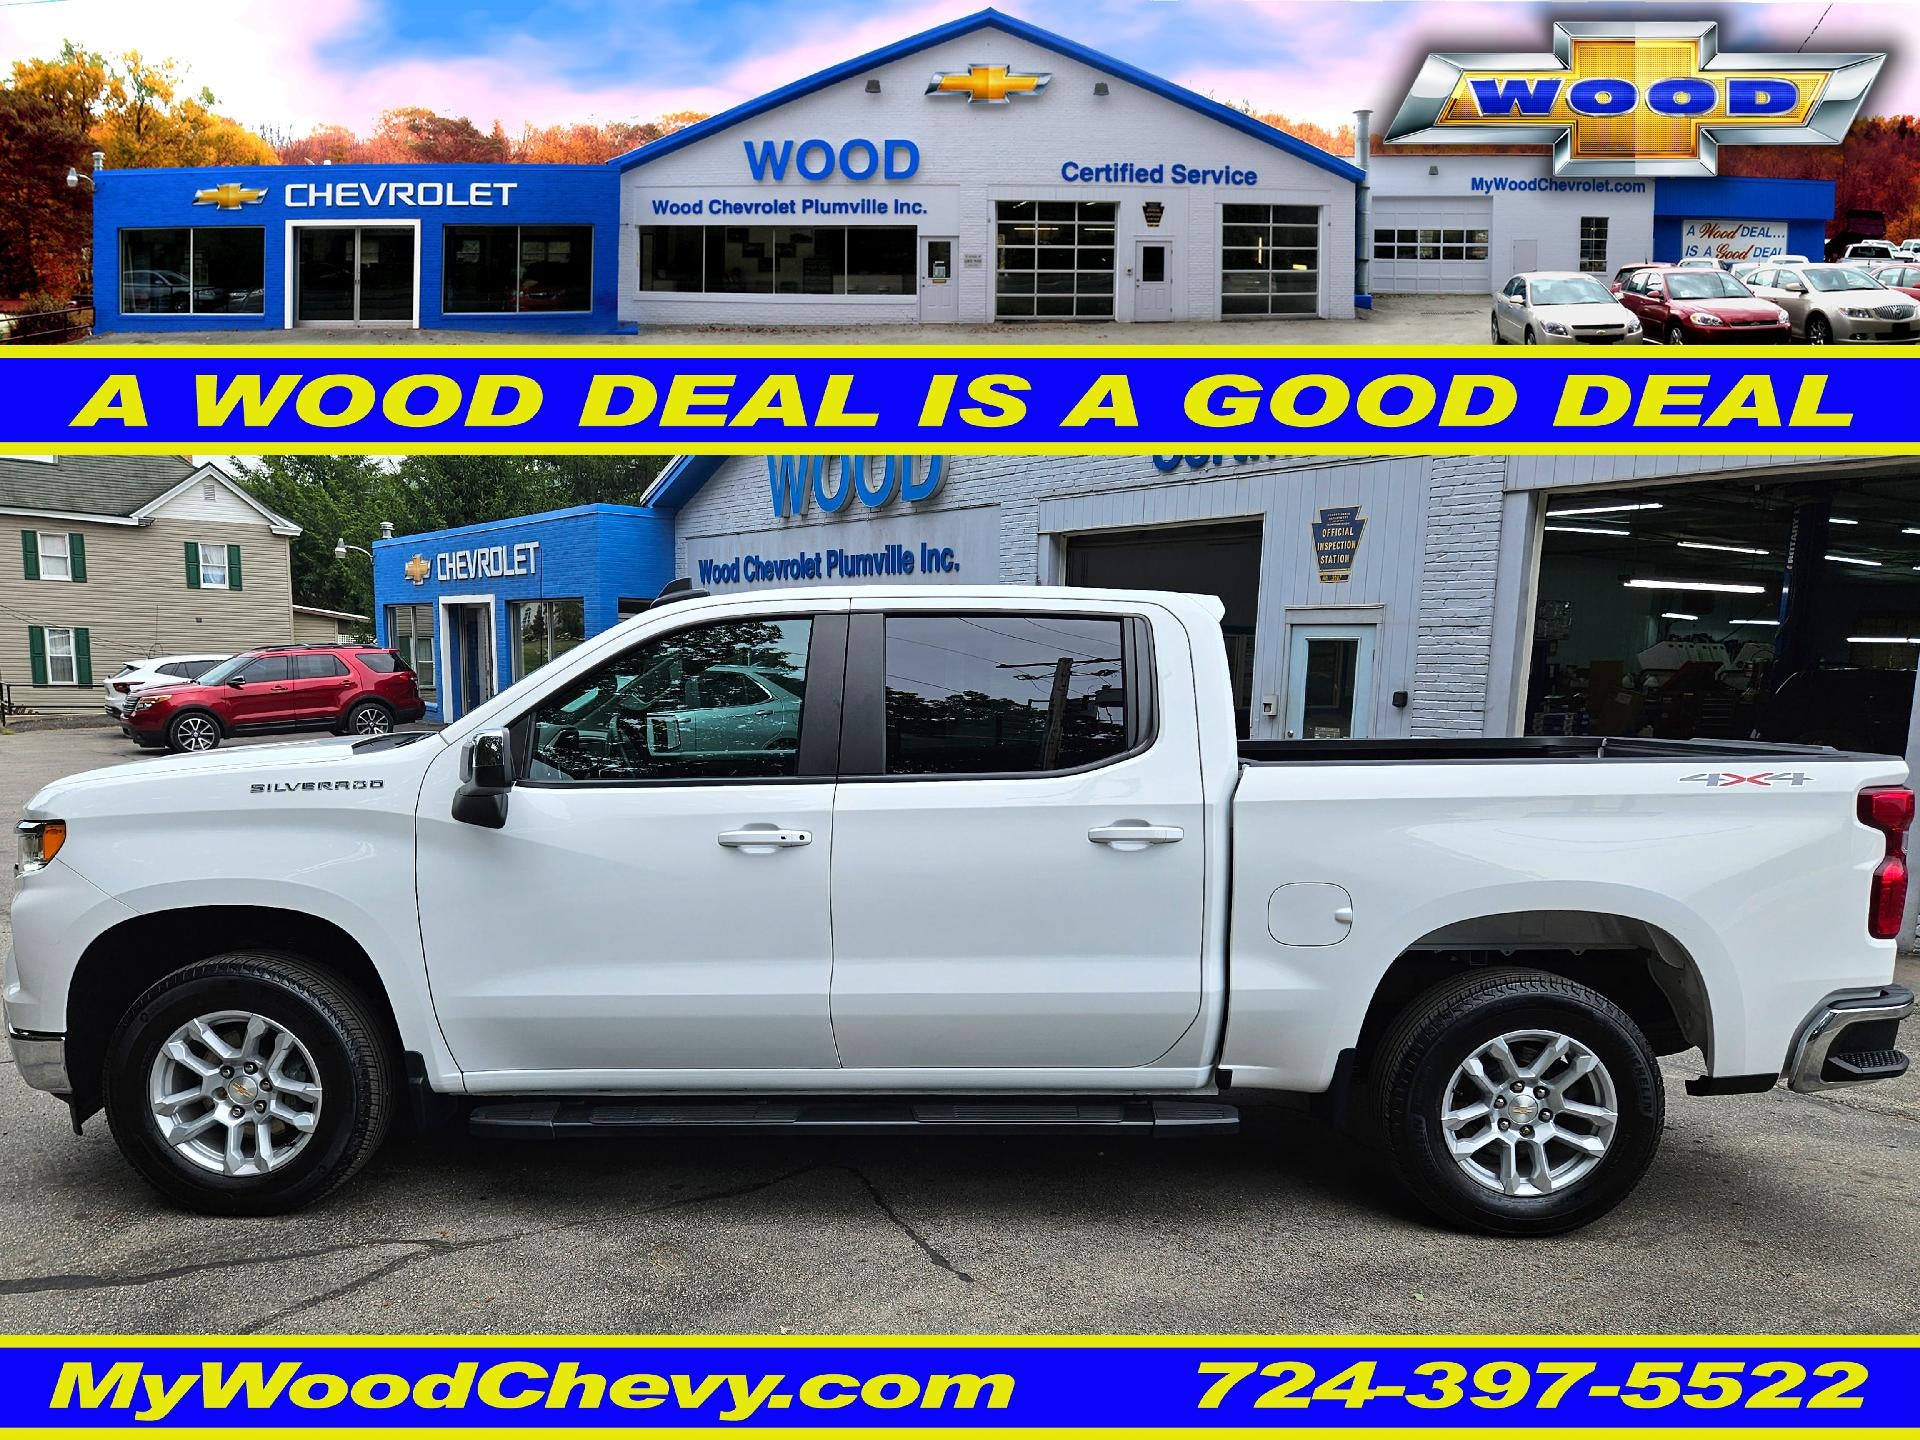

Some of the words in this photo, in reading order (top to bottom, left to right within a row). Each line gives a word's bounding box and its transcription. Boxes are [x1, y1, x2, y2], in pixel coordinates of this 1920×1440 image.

[743, 138, 921, 182] WOOD
[1060, 160, 1164, 184] Certified
[1170, 163, 1258, 186] Service
[285, 182, 518, 207] CHEVROLET
[1470, 176, 1647, 195] MyWoodChevrolet.com
[651, 199, 704, 216] Wood
[708, 198, 796, 216] Chevrolet
[801, 198, 889, 215] Plumville
[893, 198, 928, 215] Inc.
[1686, 225, 1695, 236] A
[1699, 222, 1743, 240] Wood
[1685, 244, 1699, 257] IS
[1703, 246, 1712, 257] A
[1715, 243, 1755, 260] Good
[764, 455, 949, 519] WOOD
[1322, 527, 1354, 537] OFFICIAL
[1317, 541, 1356, 551] INSPECTION
[437, 541, 540, 581] CHEVROLET
[698, 557, 740, 584] Wood
[743, 552, 822, 583] Chevrolet
[826, 544, 915, 577] Plumville
[920, 542, 960, 573] Inc.
[1320, 554, 1350, 564] STATION
[250, 779, 384, 793] SILVERADO
